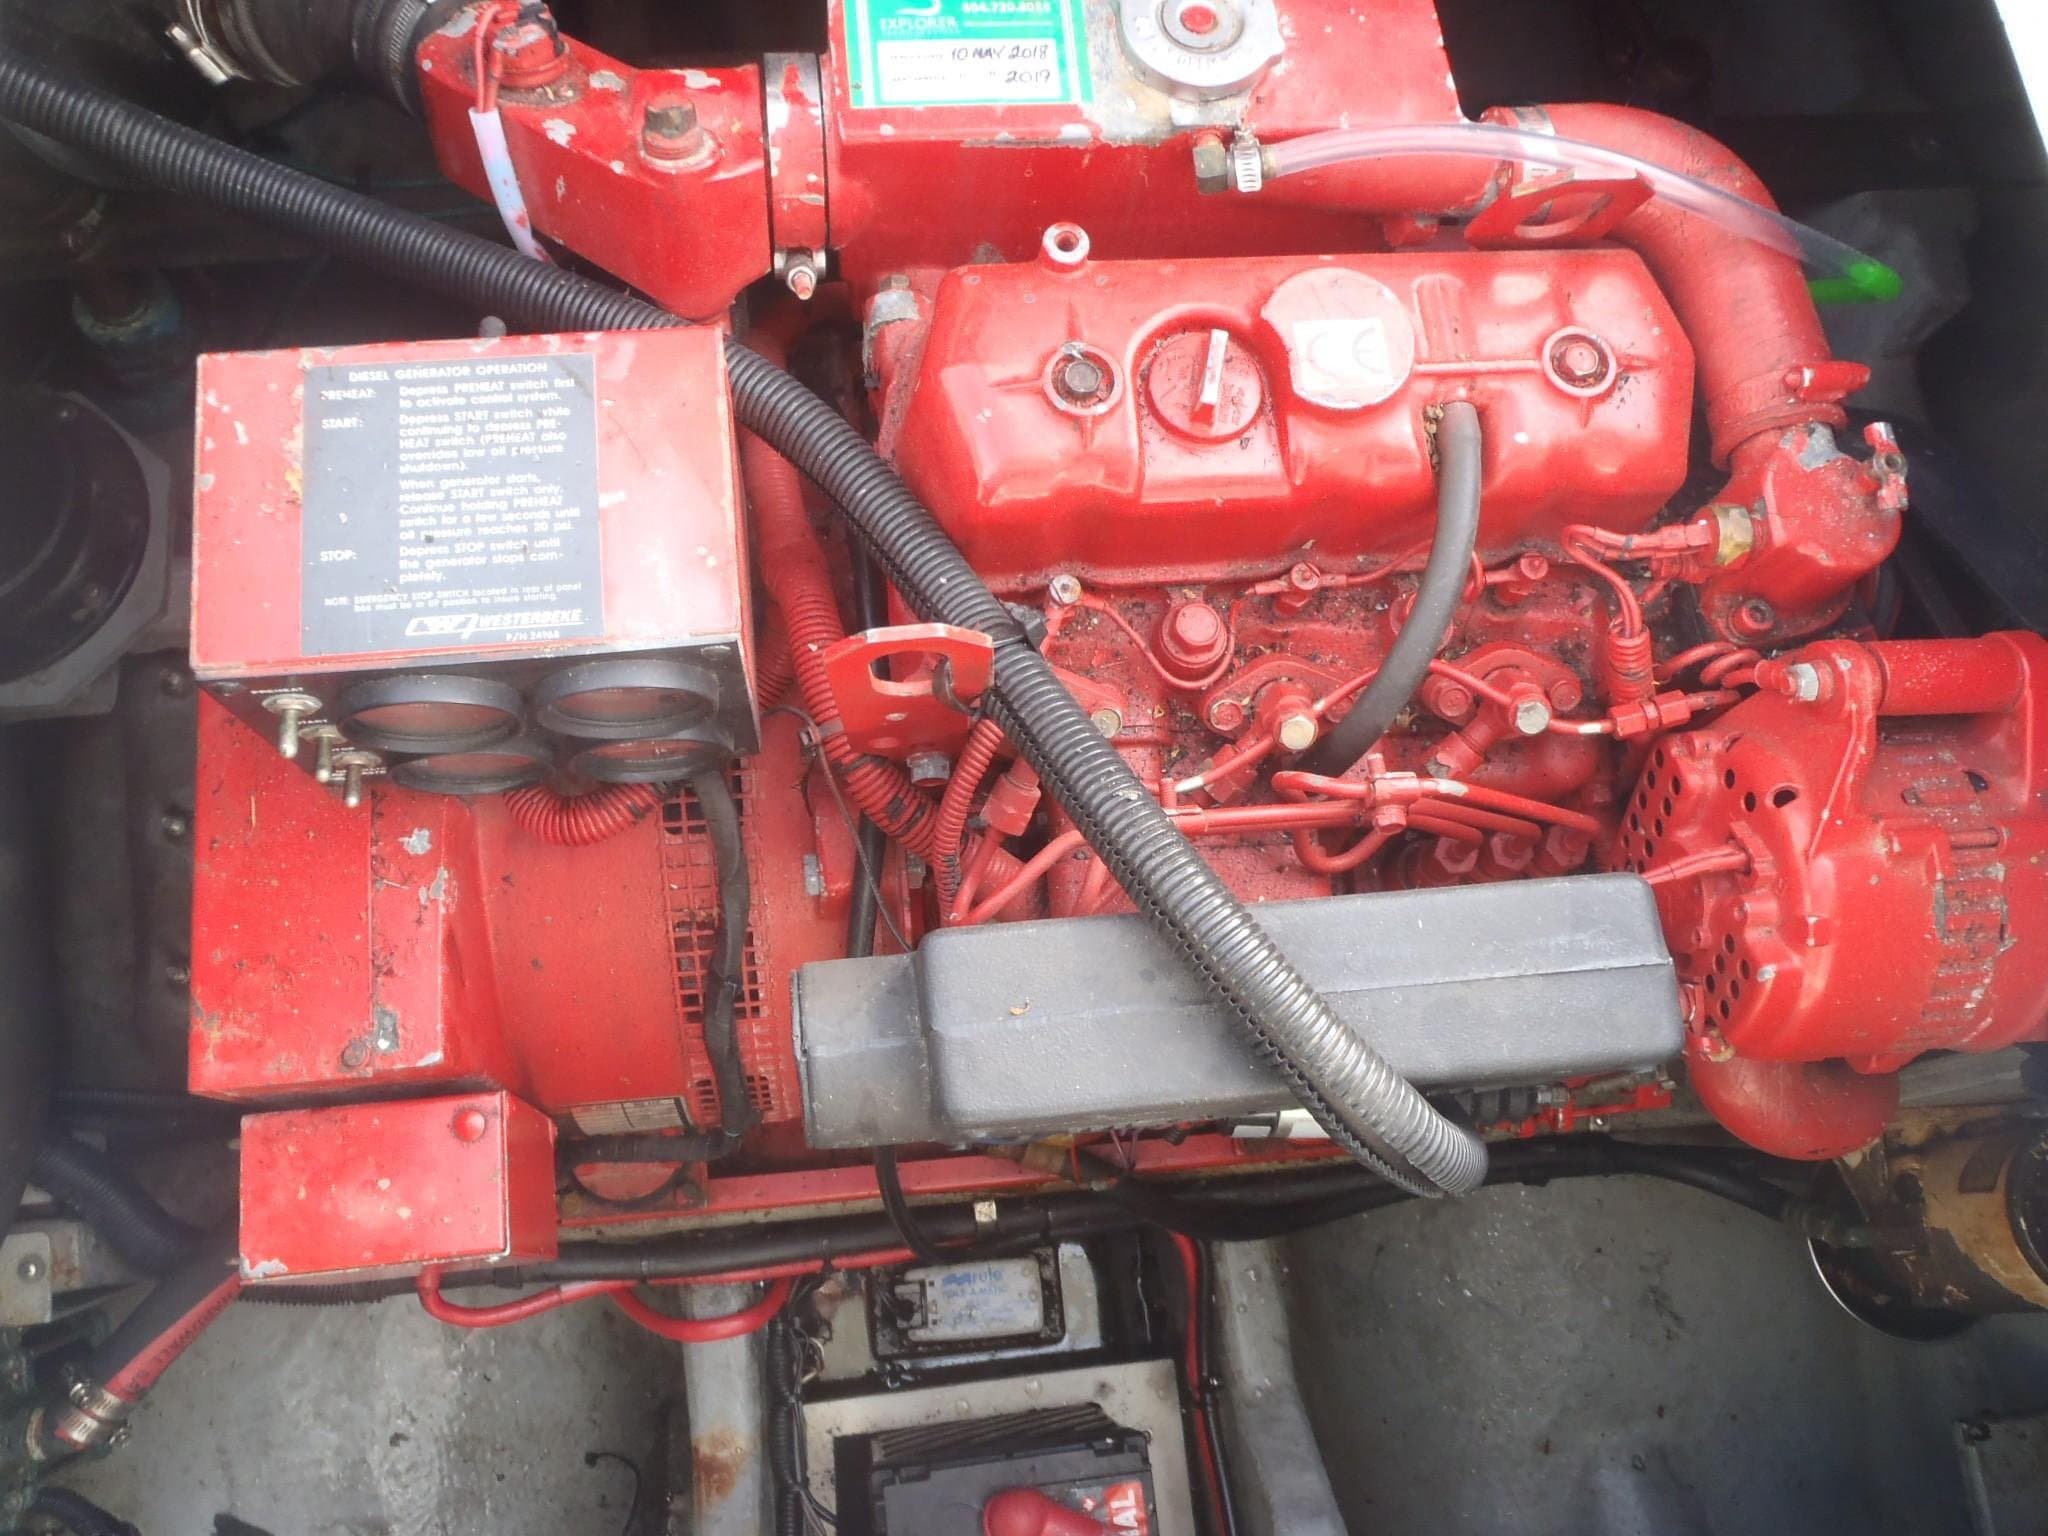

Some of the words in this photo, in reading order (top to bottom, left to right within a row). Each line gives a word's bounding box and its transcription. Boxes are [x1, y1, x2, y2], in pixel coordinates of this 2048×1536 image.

[952, 48, 968, 61] 10
[972, 46, 1006, 59] MAY
[1008, 44, 1049, 60] 2018
[348, 372, 389, 382] DIESEL
[395, 366, 470, 380] GENERATOR
[476, 363, 548, 376] OPERATION
[399, 385, 448, 397] Depress
[454, 381, 504, 393] PREHEAT
[510, 379, 548, 390] switch
[554, 378, 576, 388] first
[400, 397, 412, 408] to
[416, 394, 466, 407] activate
[471, 393, 512, 404] control
[517, 390, 561, 403] system.
[321, 417, 363, 430] START:
[399, 414, 449, 426] Depress
[454, 410, 489, 422] START
[494, 408, 532, 419] switch
[399, 425, 463, 438] continuing
[467, 423, 480, 433] to
[484, 421, 531, 434] depress
[399, 438, 430, 449] HEAT
[435, 435, 474, 446] switch
[541, 430, 566, 442] also
[463, 447, 485, 458] low
[490, 445, 506, 456] oil
[399, 479, 434, 490] When
[439, 475, 500, 489] generator
[399, 491, 444, 502] release
[450, 488, 484, 499] START
[489, 486, 528, 497] switch
[399, 503, 455, 515] Continue
[460, 500, 509, 513] holding
[513, 497, 563, 508] PREHEAT
[399, 516, 437, 528] switch
[441, 514, 457, 525] for
[462, 515, 471, 524] a
[475, 512, 497, 523] few
[501, 510, 550, 523] seconds
[555, 507, 581, 518] until
[400, 529, 415, 540] oil
[420, 527, 472, 542] pressure
[477, 524, 528, 536] reaches
[399, 545, 450, 557] Depress
[454, 542, 485, 554] STOP
[490, 540, 528, 552] switch
[534, 537, 560, 549] until
[320, 550, 357, 562] STOP:
[399, 558, 419, 569] the
[425, 555, 487, 569] generator
[492, 552, 524, 565] stops
[473, 587, 507, 598] located
[479, 609, 583, 626] WESTERBEKE
